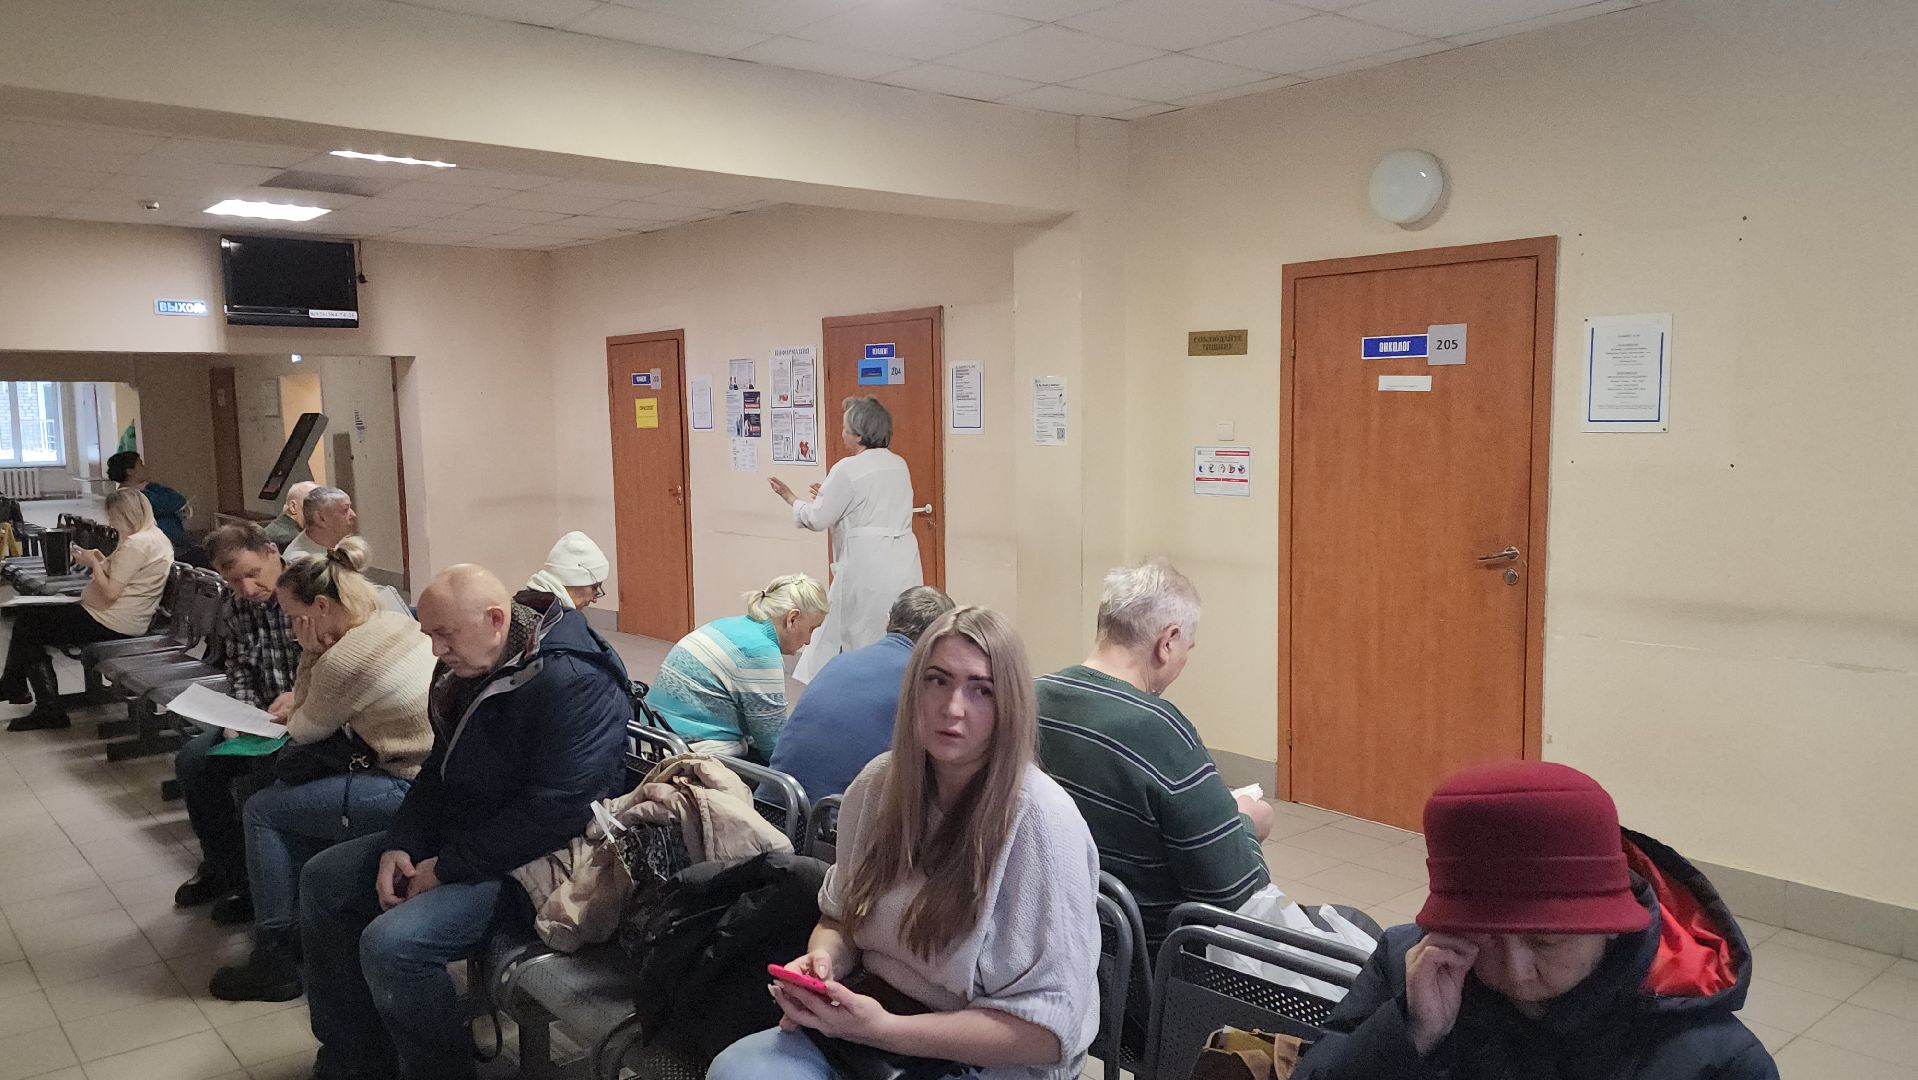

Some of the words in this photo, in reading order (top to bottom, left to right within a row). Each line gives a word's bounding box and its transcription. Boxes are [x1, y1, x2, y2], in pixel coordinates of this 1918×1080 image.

[1378, 340, 1412, 353] ОНКОЛОГ
[1436, 339, 1459, 350] 205
[891, 366, 902, 376] 204
